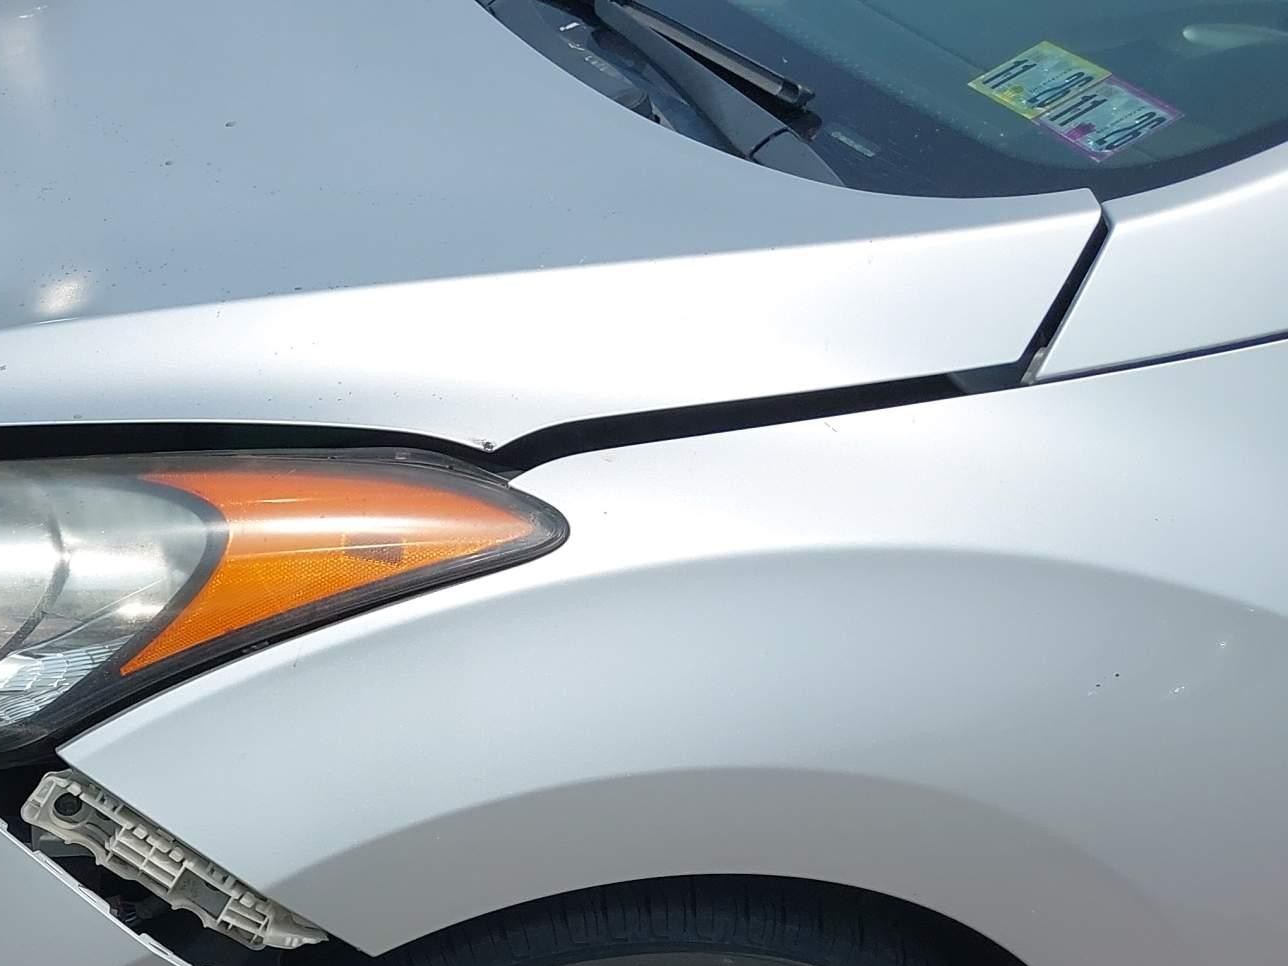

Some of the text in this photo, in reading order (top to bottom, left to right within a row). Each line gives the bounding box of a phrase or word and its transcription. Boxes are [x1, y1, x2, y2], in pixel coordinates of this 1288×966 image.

[982, 58, 1038, 90] 11
[1049, 93, 1108, 127] 11
[1094, 111, 1167, 151] 26
